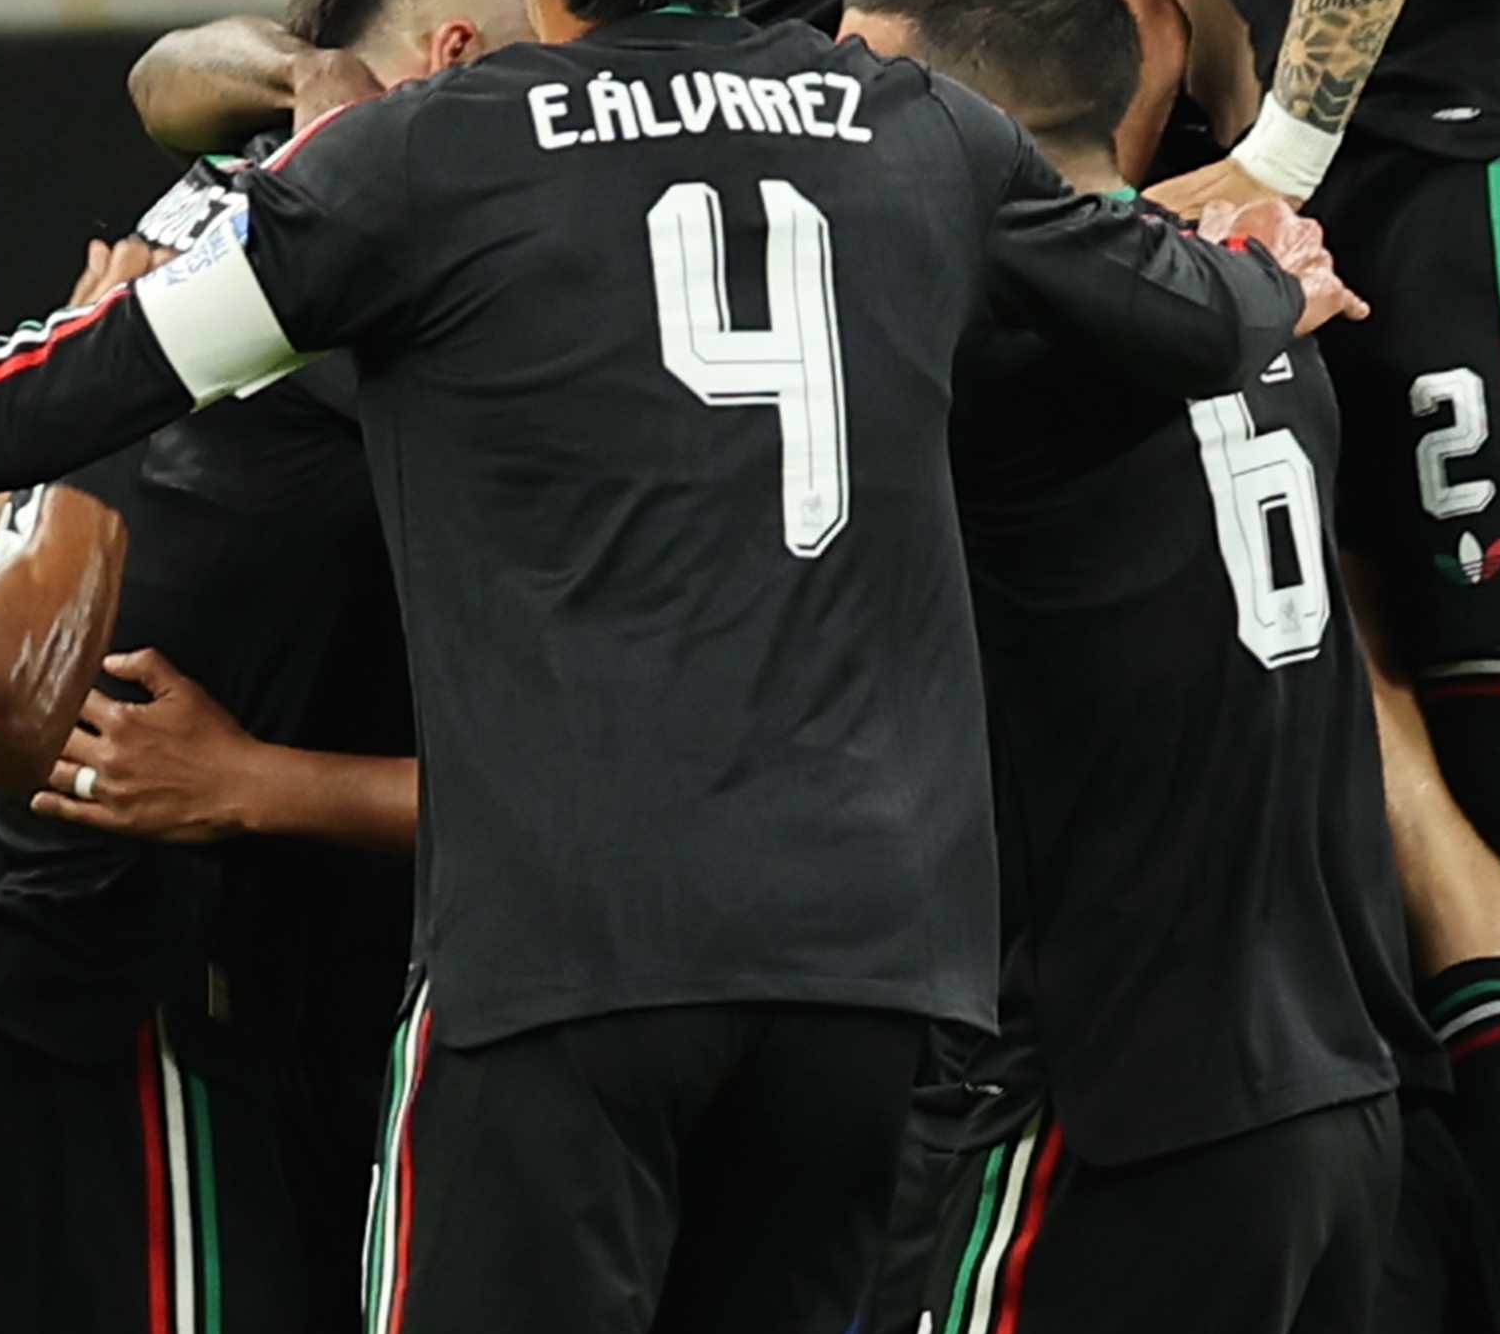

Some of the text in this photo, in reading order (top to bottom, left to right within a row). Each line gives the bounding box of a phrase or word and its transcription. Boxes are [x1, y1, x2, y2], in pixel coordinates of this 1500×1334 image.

[527, 70, 873, 151] E.ÁLVAREZ
[647, 179, 851, 558] 4
[1409, 367, 1497, 520] 2
[1188, 391, 1330, 670] 6
